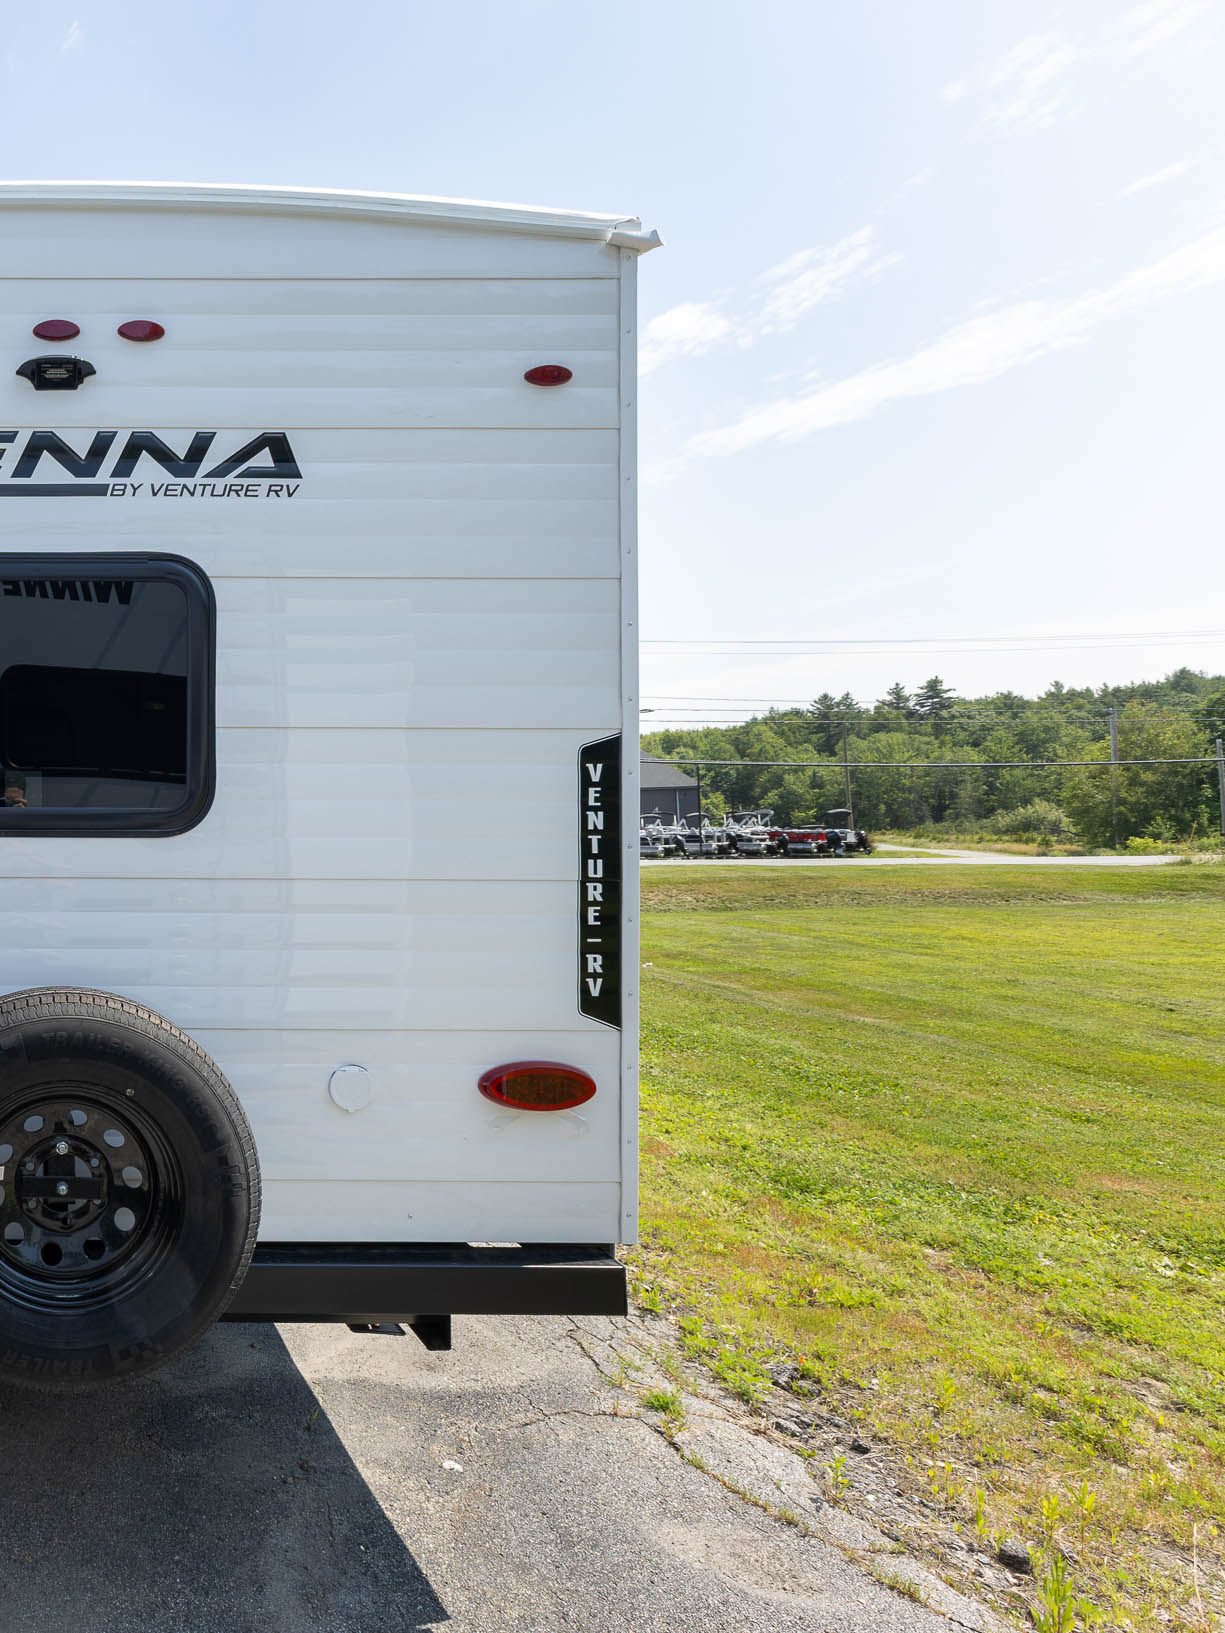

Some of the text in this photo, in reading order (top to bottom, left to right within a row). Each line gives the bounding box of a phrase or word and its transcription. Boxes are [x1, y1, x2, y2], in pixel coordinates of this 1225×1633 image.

[110, 483, 301, 498] BY VENTURE RV
[40, 1031, 133, 1054] TRAILER
